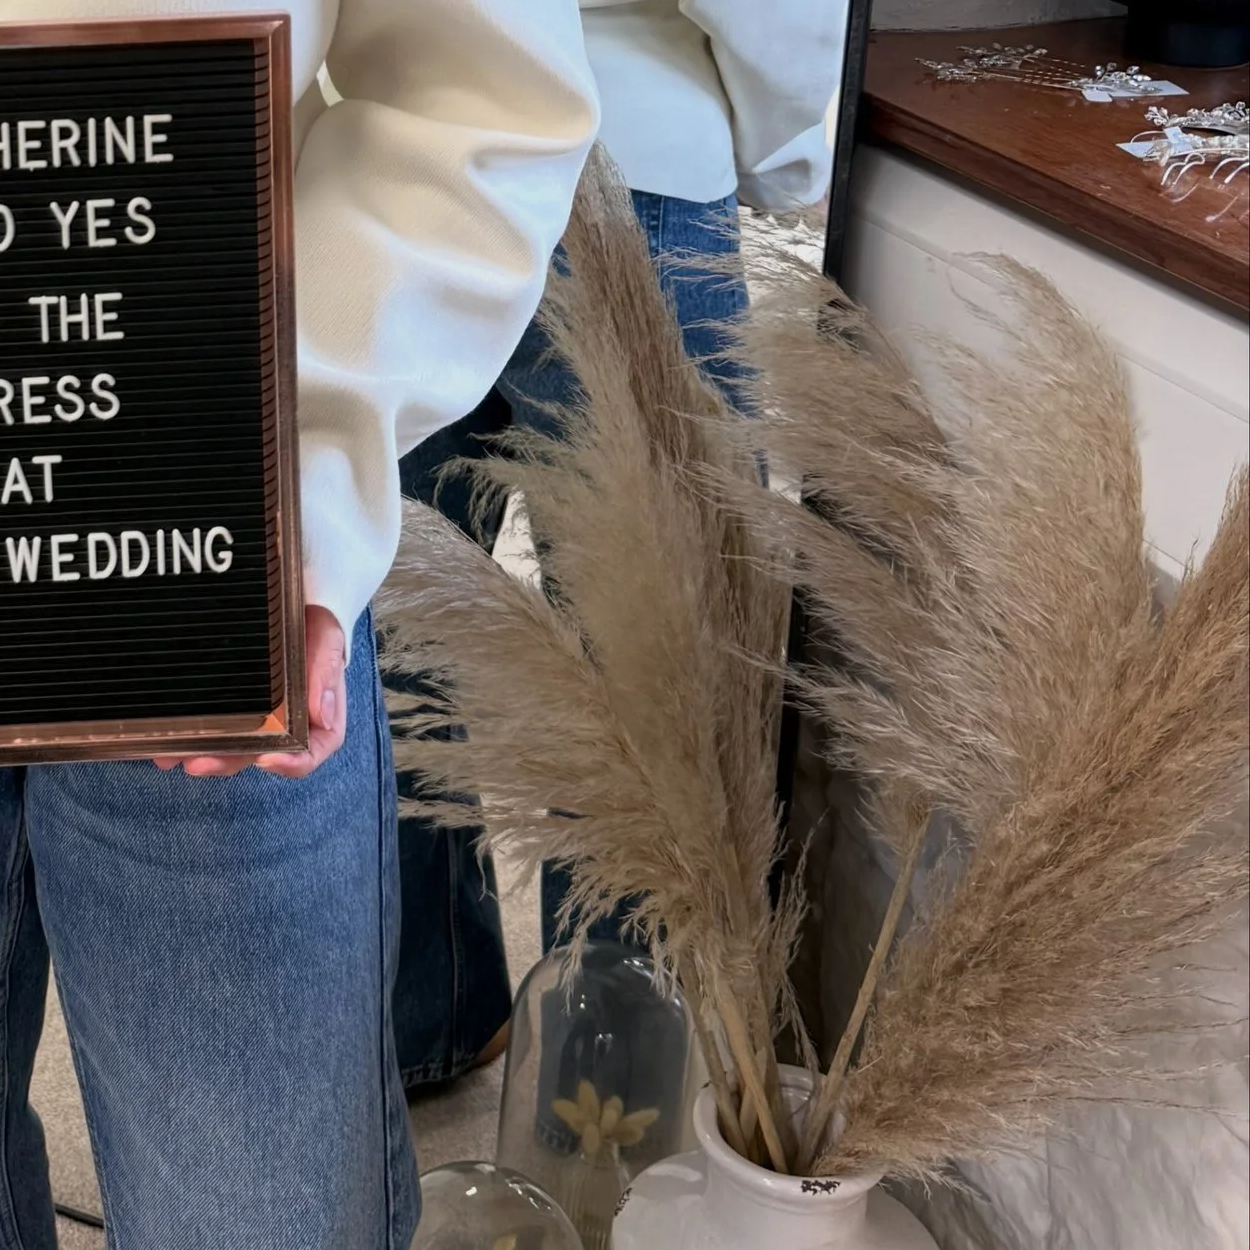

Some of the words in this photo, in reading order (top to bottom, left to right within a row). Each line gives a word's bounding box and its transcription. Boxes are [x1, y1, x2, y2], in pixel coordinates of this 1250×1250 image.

[49, 195, 157, 250] YES
[28, 291, 125, 344] THE
[1, 454, 63, 505] AT
[5, 525, 234, 584] WEDDING
